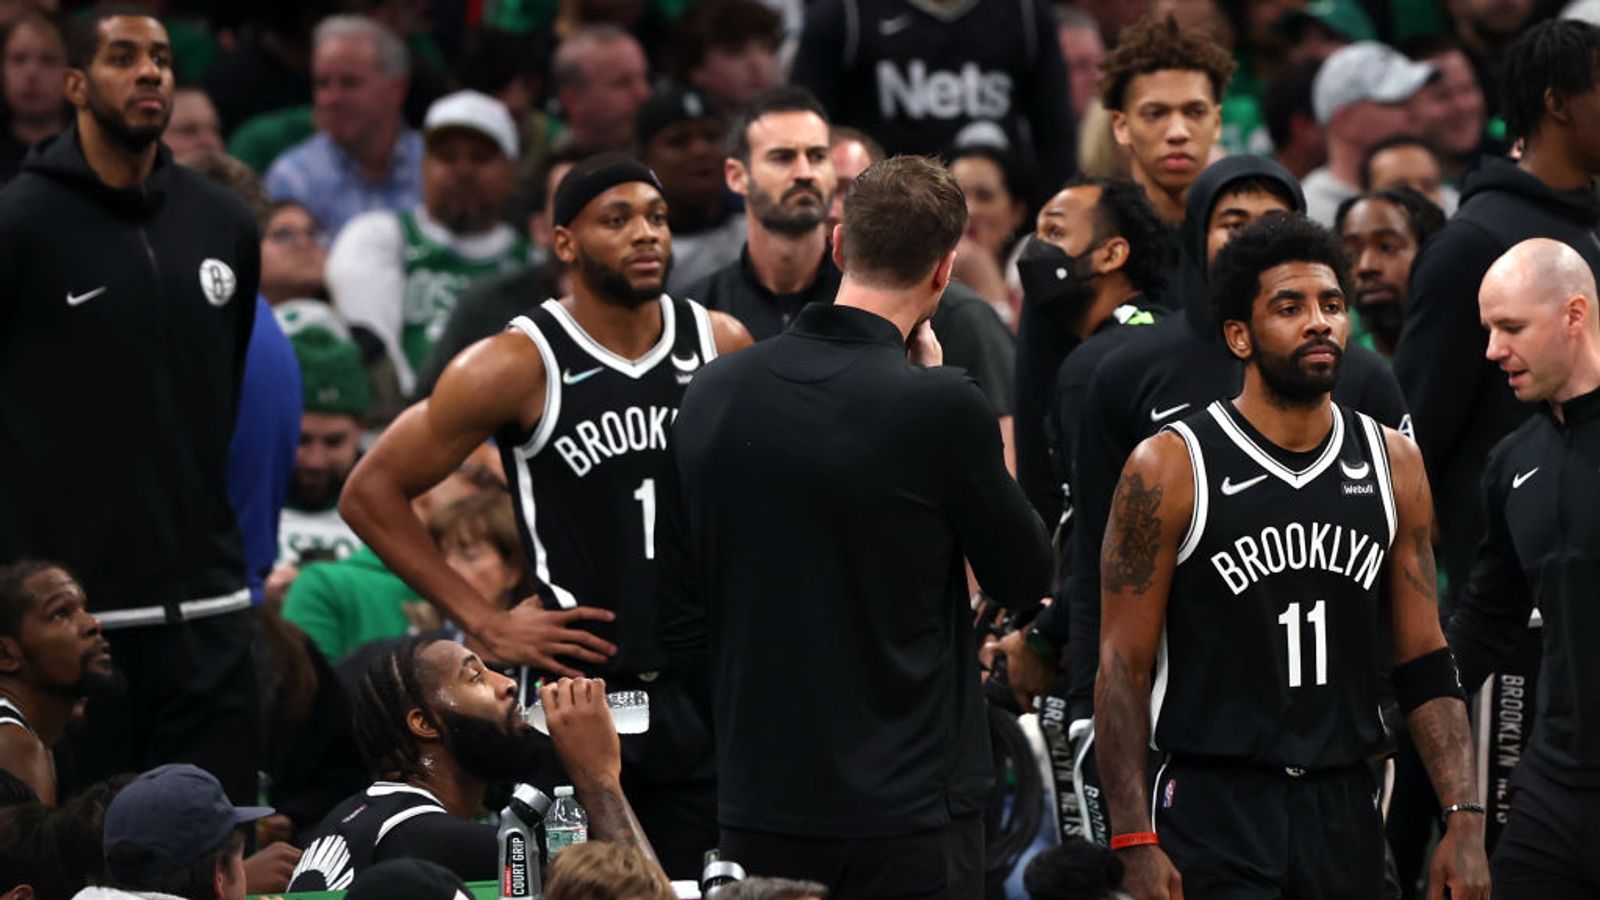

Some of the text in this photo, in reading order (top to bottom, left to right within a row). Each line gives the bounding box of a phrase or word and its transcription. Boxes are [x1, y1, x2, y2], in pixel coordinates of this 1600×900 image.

[877, 59, 1013, 119] Nets
[554, 405, 679, 478] BROOK
[633, 478, 656, 560] 1
[1343, 483, 1374, 495] Webull
[1211, 521, 1385, 596] BROOKLYN
[1278, 599, 1328, 688] 11
[1498, 674, 1525, 768] BROOKLYN
[512, 837, 525, 896] COURT GRIP
